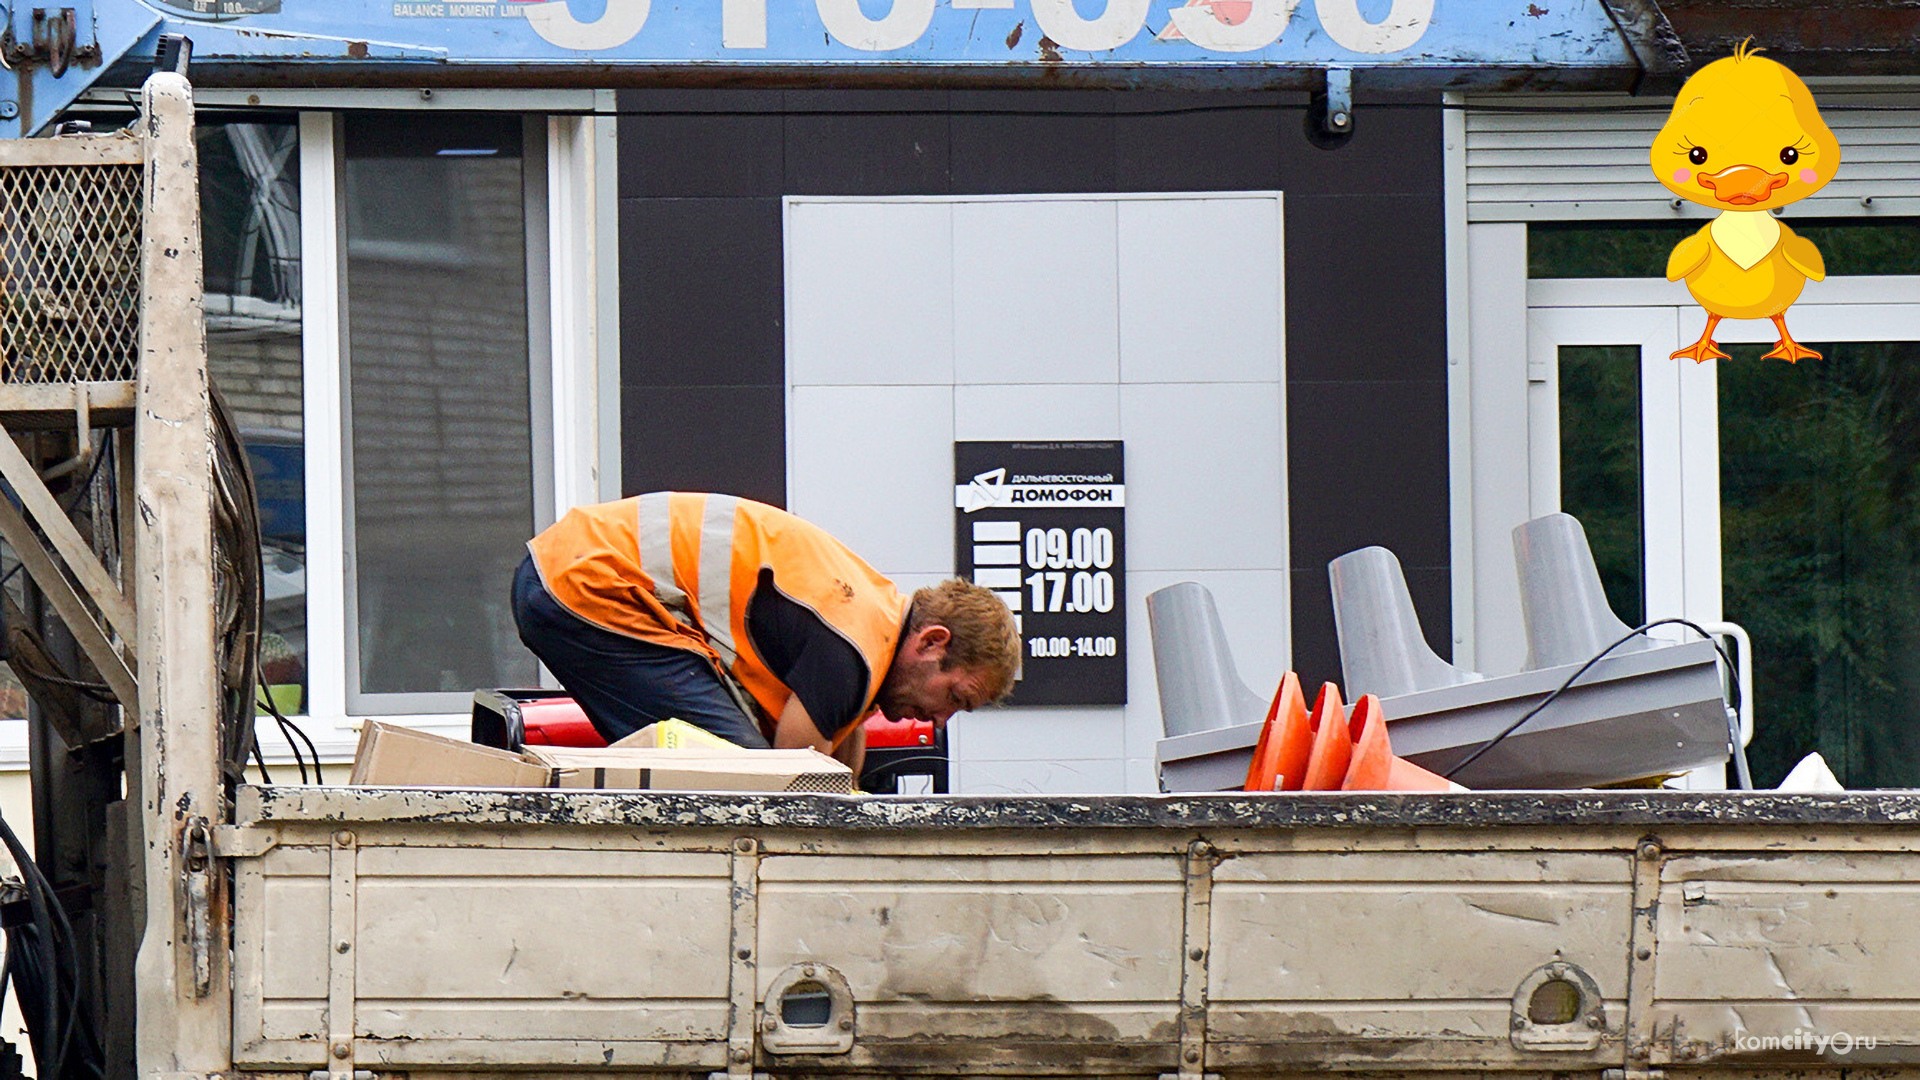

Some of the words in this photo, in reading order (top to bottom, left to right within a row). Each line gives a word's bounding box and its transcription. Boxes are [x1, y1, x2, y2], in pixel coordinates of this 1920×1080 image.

[393, 3, 444, 17] BALANCE
[449, 3, 495, 17] MOMENT
[1011, 473, 1114, 484] ДАЛЬНЕВОСТОЧНЫЙ
[1011, 488, 1113, 504] ДОМОФОН
[1026, 527, 1114, 570] 09.00
[1025, 571, 1114, 614] 17.00
[1028, 636, 1117, 658] 10.00-14.00
